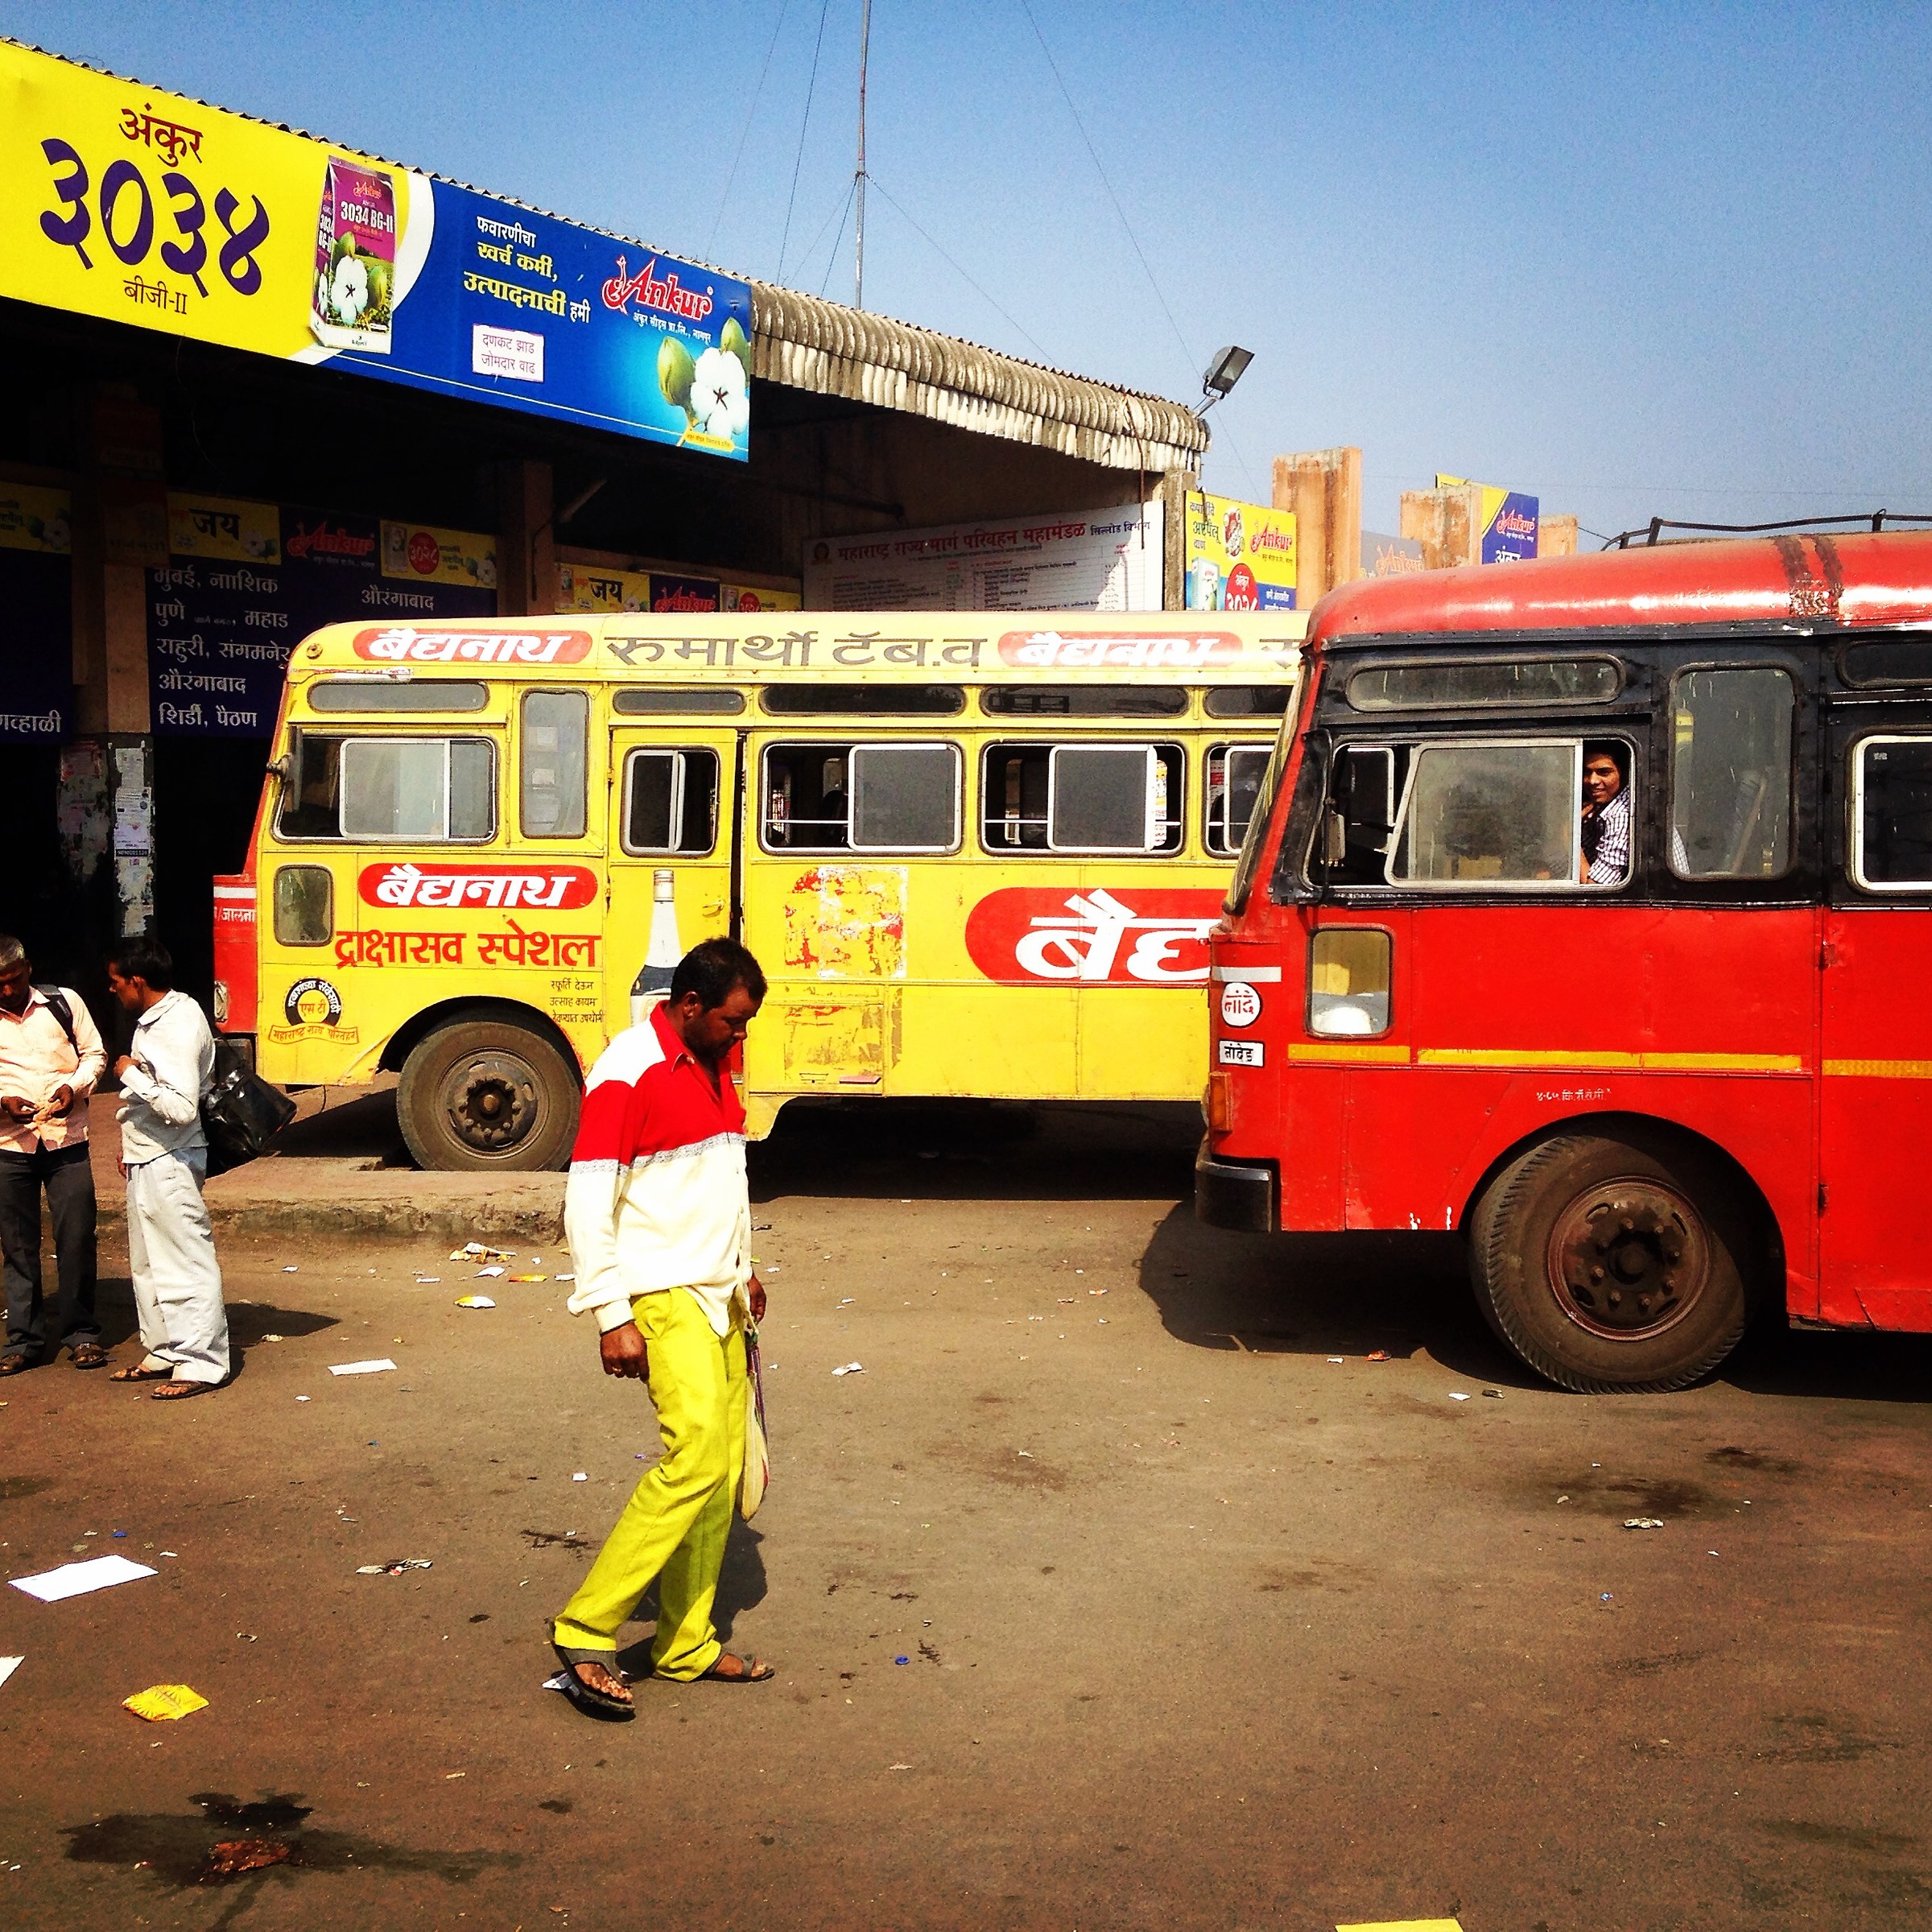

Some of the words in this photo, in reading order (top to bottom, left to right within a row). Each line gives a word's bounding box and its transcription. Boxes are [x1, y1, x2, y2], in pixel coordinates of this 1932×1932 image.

[118, 103, 204, 167] अंकुर
[39, 138, 270, 299] ३०३४
[341, 200, 369, 225] 3034
[477, 216, 537, 248] फवारणीचा
[477, 242, 514, 265] खर्च
[464, 270, 567, 316] उत्पादनाची
[569, 298, 591, 323] हमी
[602, 254, 712, 321] Ankur
[482, 334, 513, 349] दणकट
[516, 340, 535, 354] झाड
[481, 350, 515, 370] जोमदार
[188, 508, 241, 541] जय
[838, 543, 890, 562] महाराष्ट्र
[894, 540, 924, 555] राज्य
[963, 528, 1018, 548] परिवहन
[1022, 520, 1087, 545] महामंडळ
[361, 584, 435, 611] औरंगाबाद
[588, 576, 623, 603] जय
[154, 597, 187, 627] पुणे
[218, 638, 291, 662] संगमनेर
[369, 628, 572, 663] बैद्यनाथ
[1014, 631, 1220, 667] बैद्यनाथ
[159, 668, 246, 694] औरंगाबाद
[215, 704, 258, 728] पैठण
[377, 863, 576, 907] बैद्यनाथ
[334, 930, 466, 969] द्राक्षासव
[477, 919, 602, 968] स्पेशल
